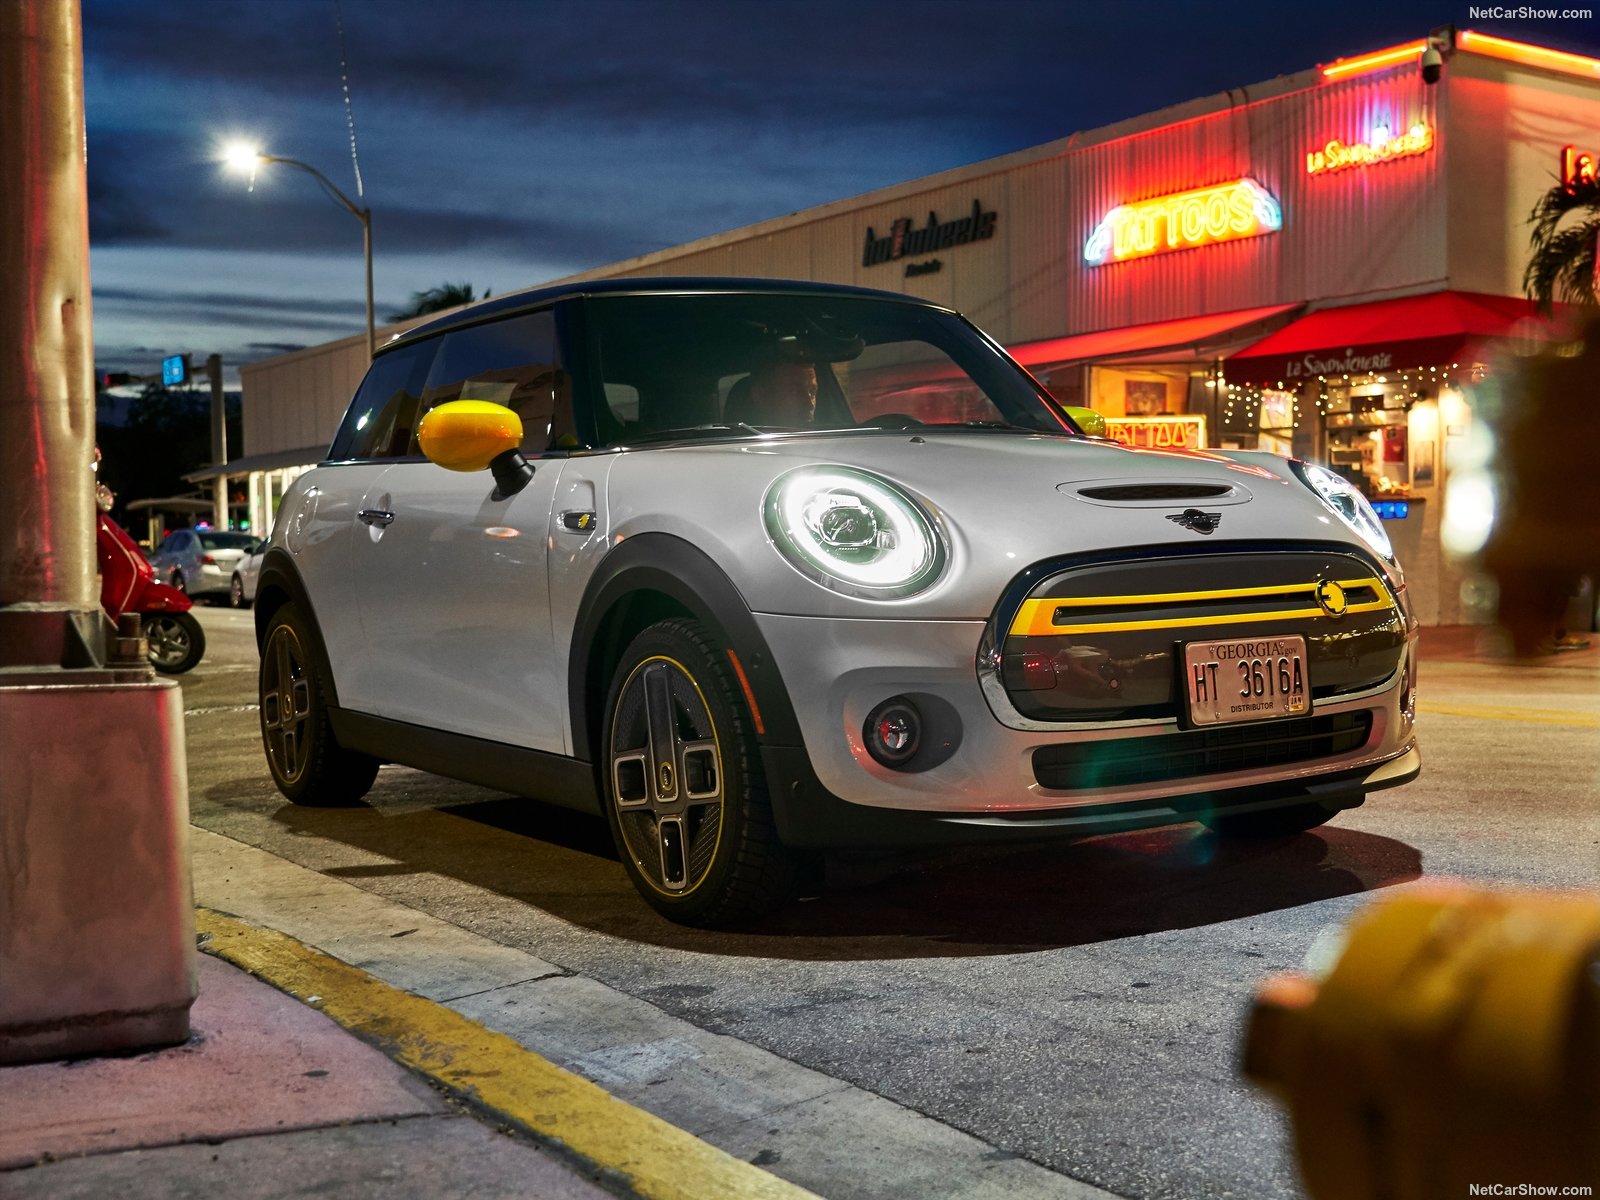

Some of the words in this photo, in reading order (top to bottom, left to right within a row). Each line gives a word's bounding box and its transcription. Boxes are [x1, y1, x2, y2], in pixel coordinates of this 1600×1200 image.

[1112, 188, 1256, 258] TATTOOS
[1193, 662, 1219, 703] HT
[1238, 656, 1304, 698] 3616A
[1230, 702, 1274, 713] DISTRIBUTOR
